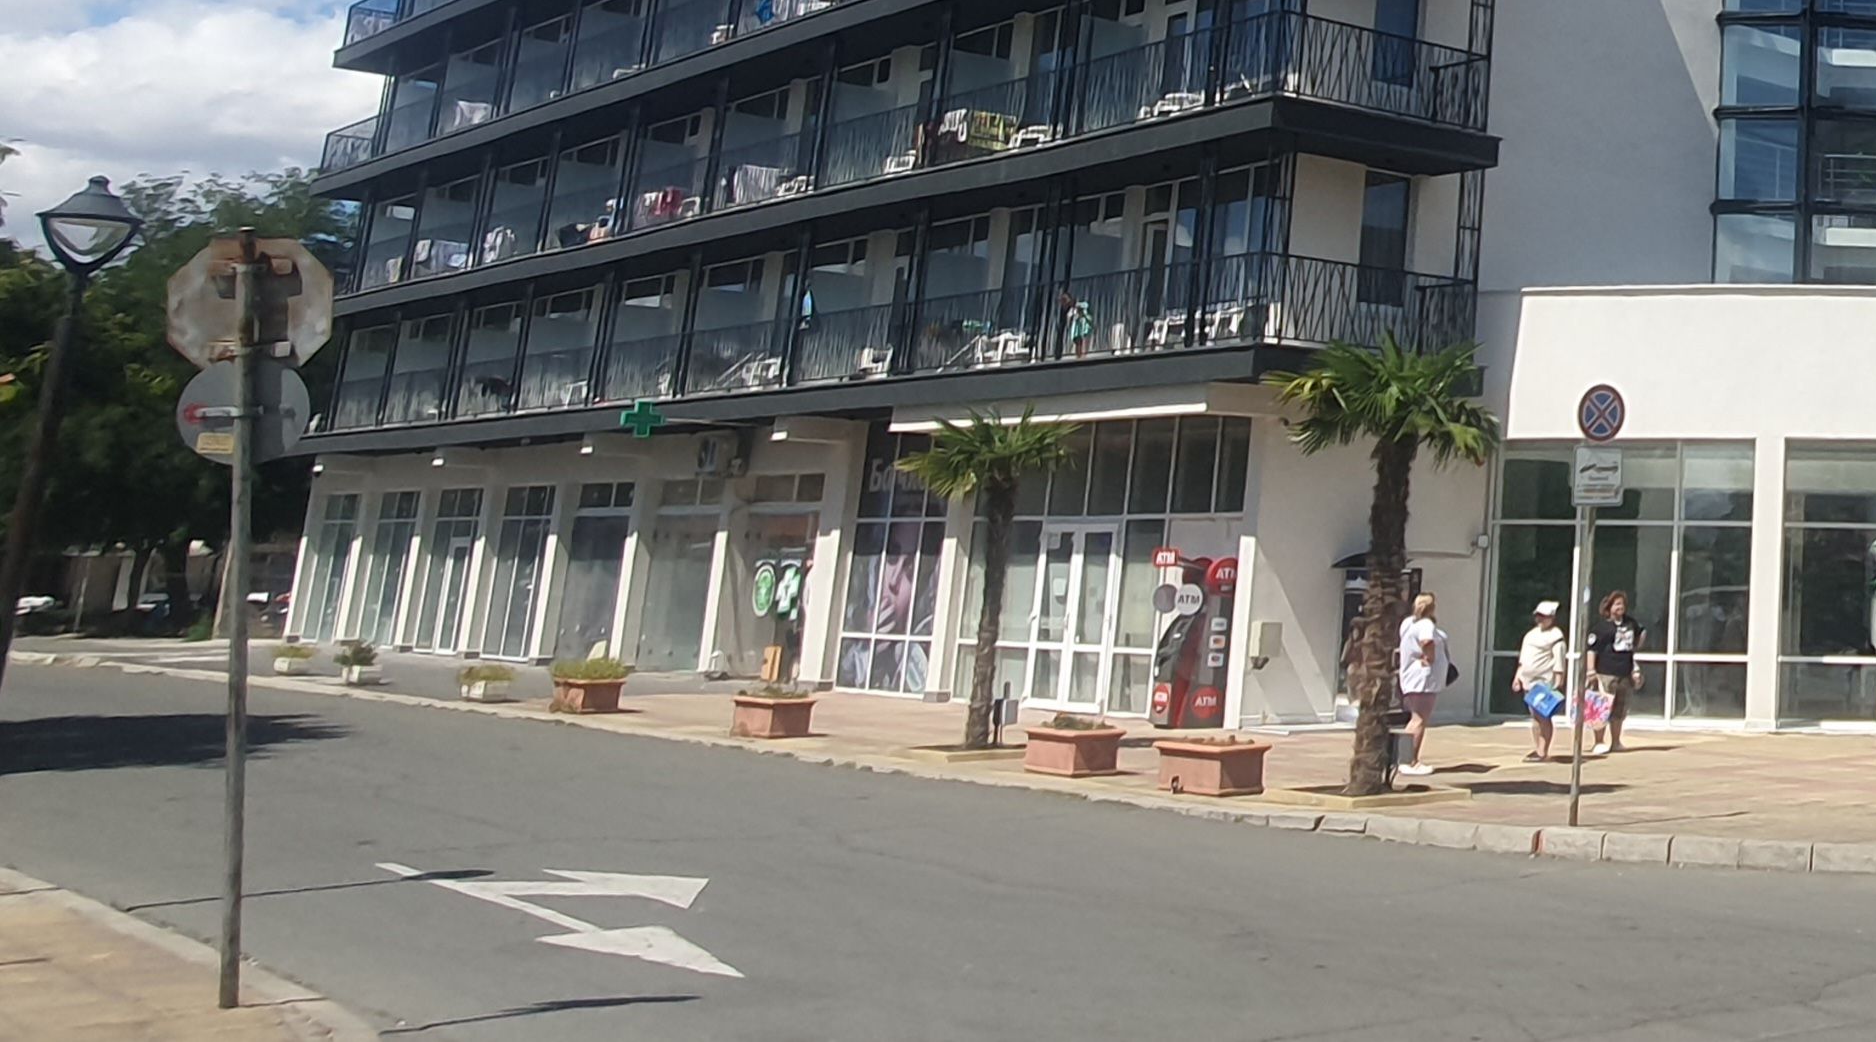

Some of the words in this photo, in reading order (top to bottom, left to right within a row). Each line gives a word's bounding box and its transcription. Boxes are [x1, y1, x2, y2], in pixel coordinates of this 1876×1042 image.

[1155, 550, 1177, 565] ATM
[1177, 593, 1201, 605] ATM
[1194, 695, 1218, 708] ATM
